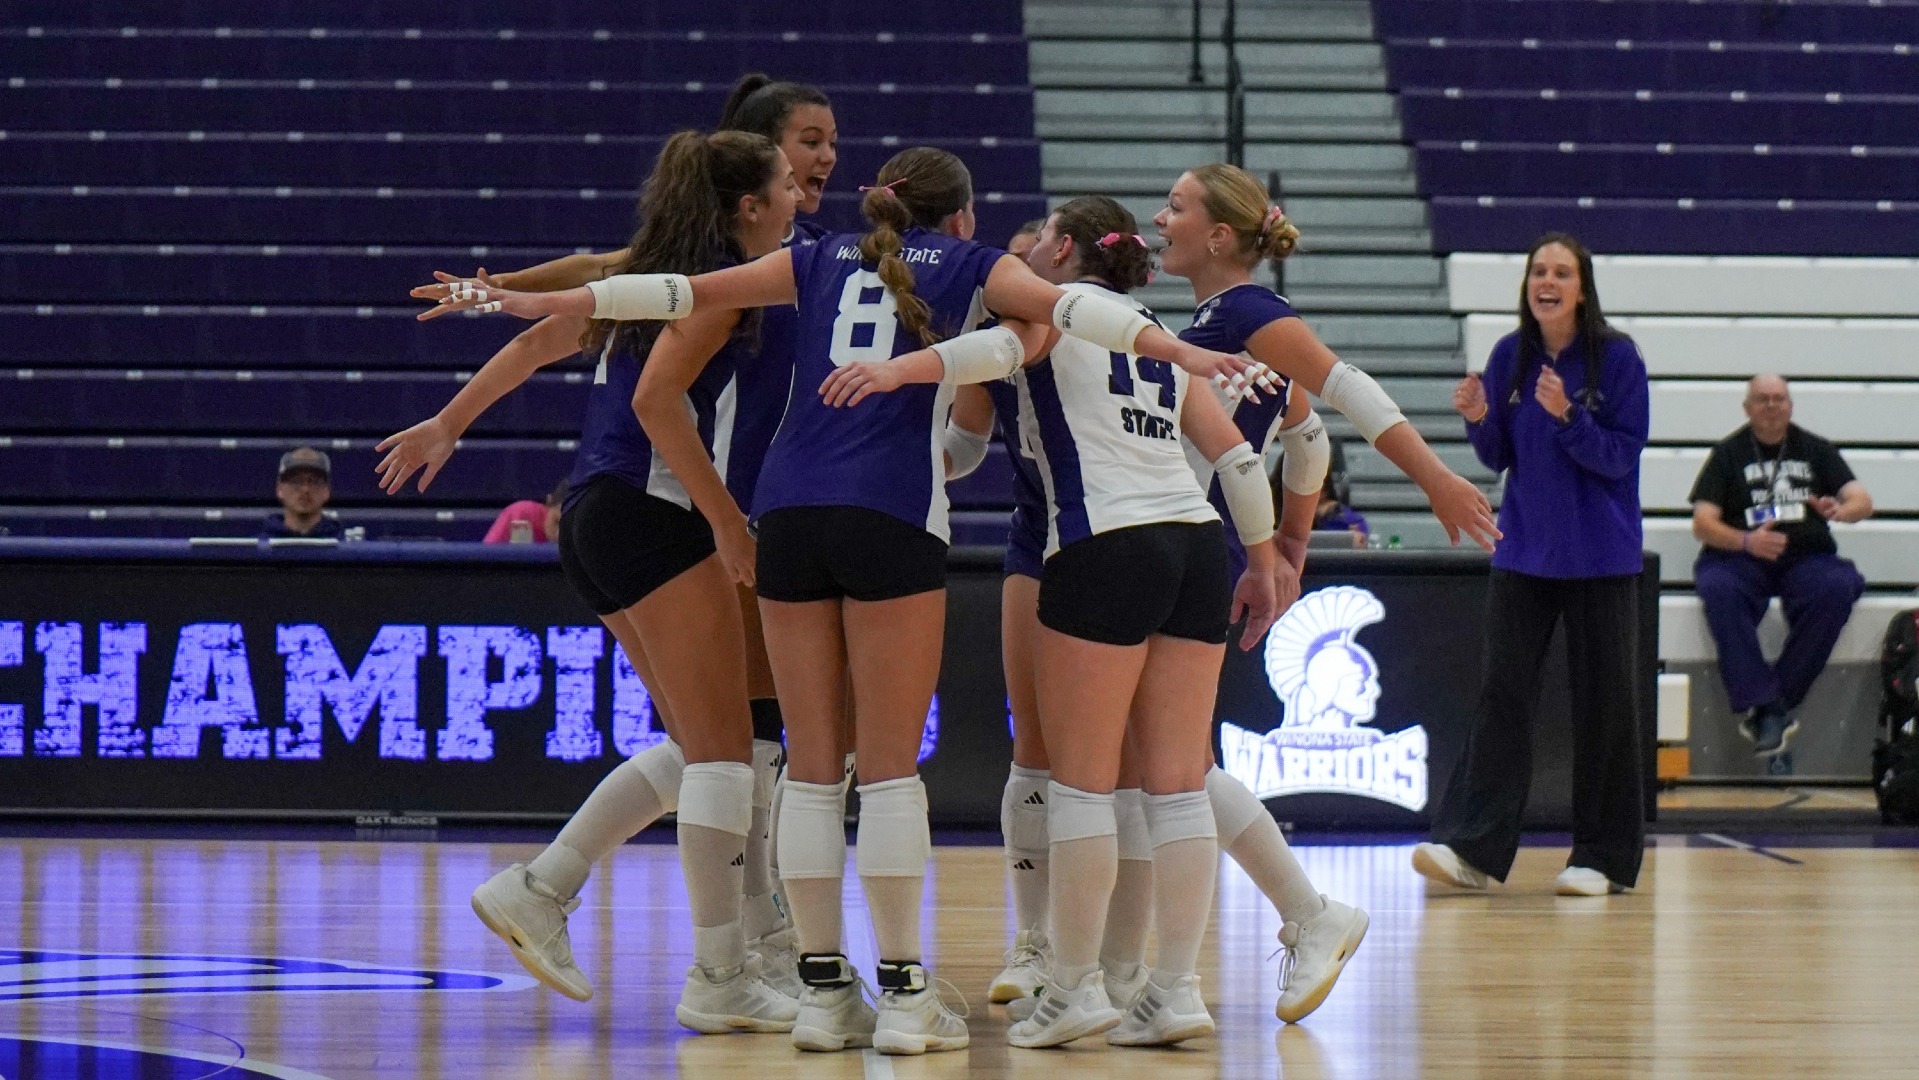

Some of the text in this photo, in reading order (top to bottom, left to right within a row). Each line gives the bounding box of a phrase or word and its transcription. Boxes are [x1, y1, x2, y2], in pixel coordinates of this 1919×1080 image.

[829, 268, 898, 367] 8
[1108, 350, 1176, 414] 14
[1221, 722, 1429, 811] WARRIORS
[1335, 731, 1371, 747] STATE
